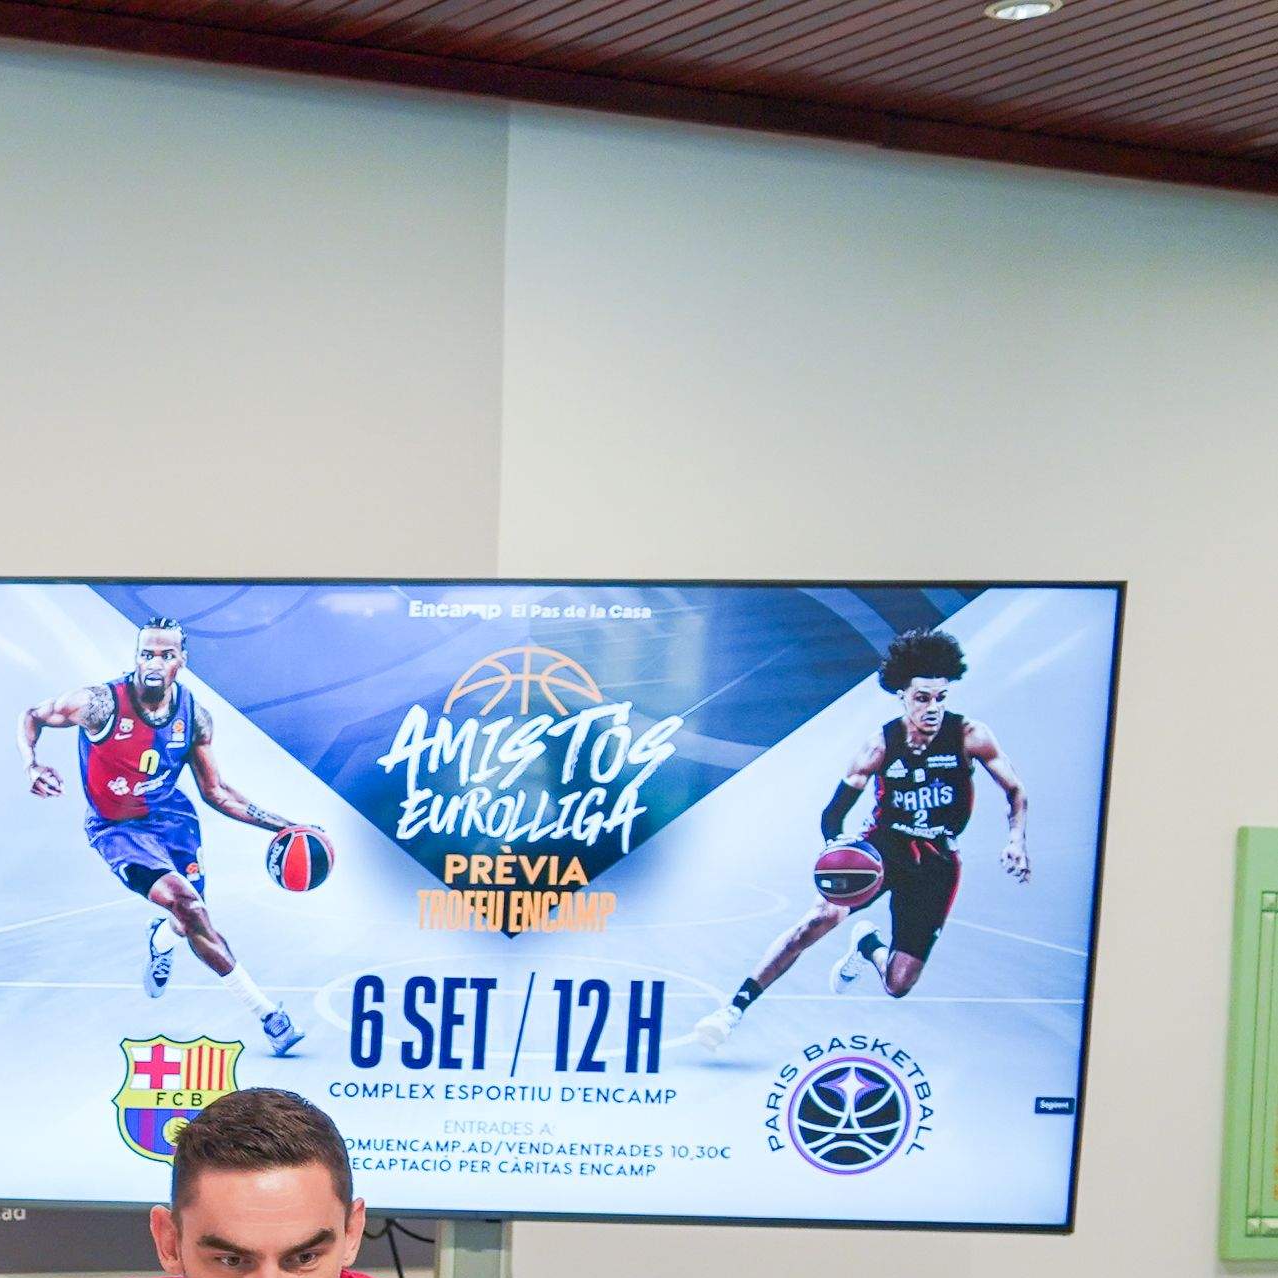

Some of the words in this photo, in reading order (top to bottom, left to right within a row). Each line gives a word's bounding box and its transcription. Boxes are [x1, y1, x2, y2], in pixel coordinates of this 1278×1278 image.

[408, 600, 503, 620] Encamp
[511, 604, 527, 619] El
[530, 604, 561, 619] Pas
[564, 604, 586, 619] de
[590, 604, 607, 619] la
[609, 605, 652, 620] Casa
[893, 785, 955, 811] PARIS
[396, 783, 648, 854] EUROLLIGA
[914, 809, 929, 828] 2
[444, 844, 590, 886] PRÈVIA
[416, 888, 505, 933] TROFEU
[509, 890, 618, 934] ENCAMP
[349, 974, 385, 1070] 6
[400, 975, 498, 1071] SET
[552, 978, 612, 1073] 12
[624, 979, 666, 1074] H
[328, 1081, 436, 1100] COMPLEX
[443, 1083, 553, 1103] ESPORTIU
[560, 1085, 678, 1106] D'ENCAMP
[764, 1063, 799, 1153] PARIS
[802, 1034, 935, 1157] BASKETBALL
[443, 1119, 534, 1136] ENTRADES
[344, 1137, 664, 1159] OMUENCAMP.AD/VENDAENTRADES
[351, 1154, 453, 1172] ECAPTACIÓ
[458, 1158, 491, 1174] PER
[497, 1156, 573, 1176] CÀRITAS
[579, 1161, 657, 1178] ENCAMP
